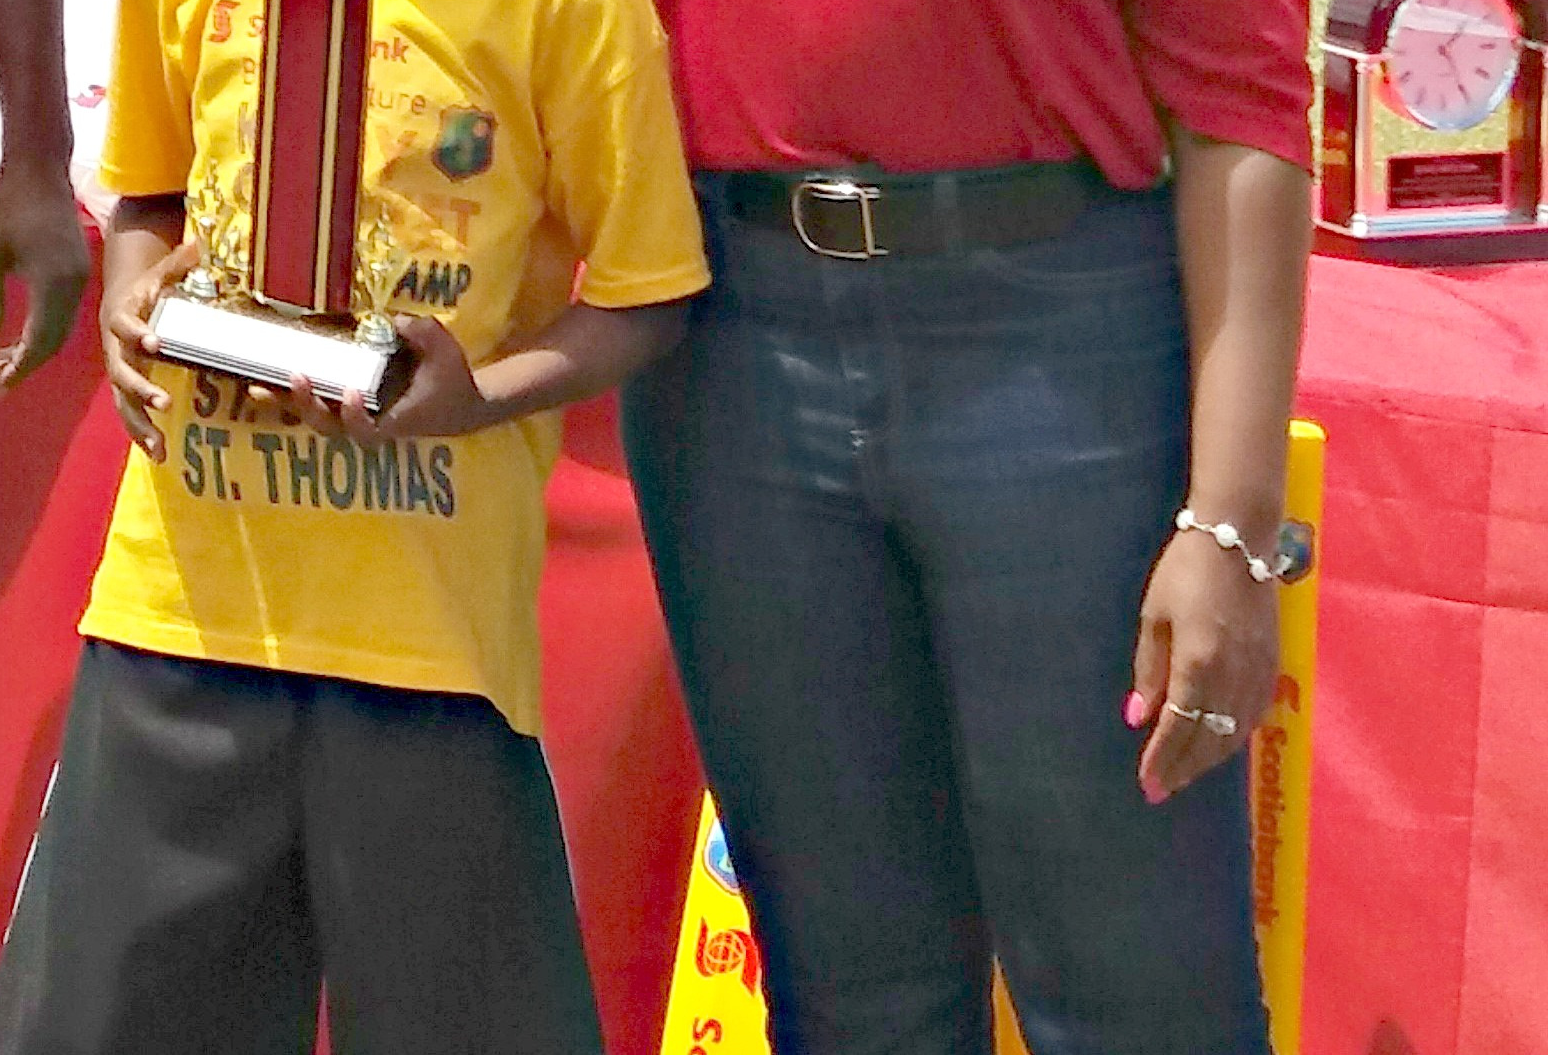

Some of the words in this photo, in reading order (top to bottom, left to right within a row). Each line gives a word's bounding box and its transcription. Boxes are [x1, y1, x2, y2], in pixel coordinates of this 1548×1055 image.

[392, 258, 472, 308] AMP
[183, 422, 241, 501] ST.
[252, 429, 455, 519] THOMAS
